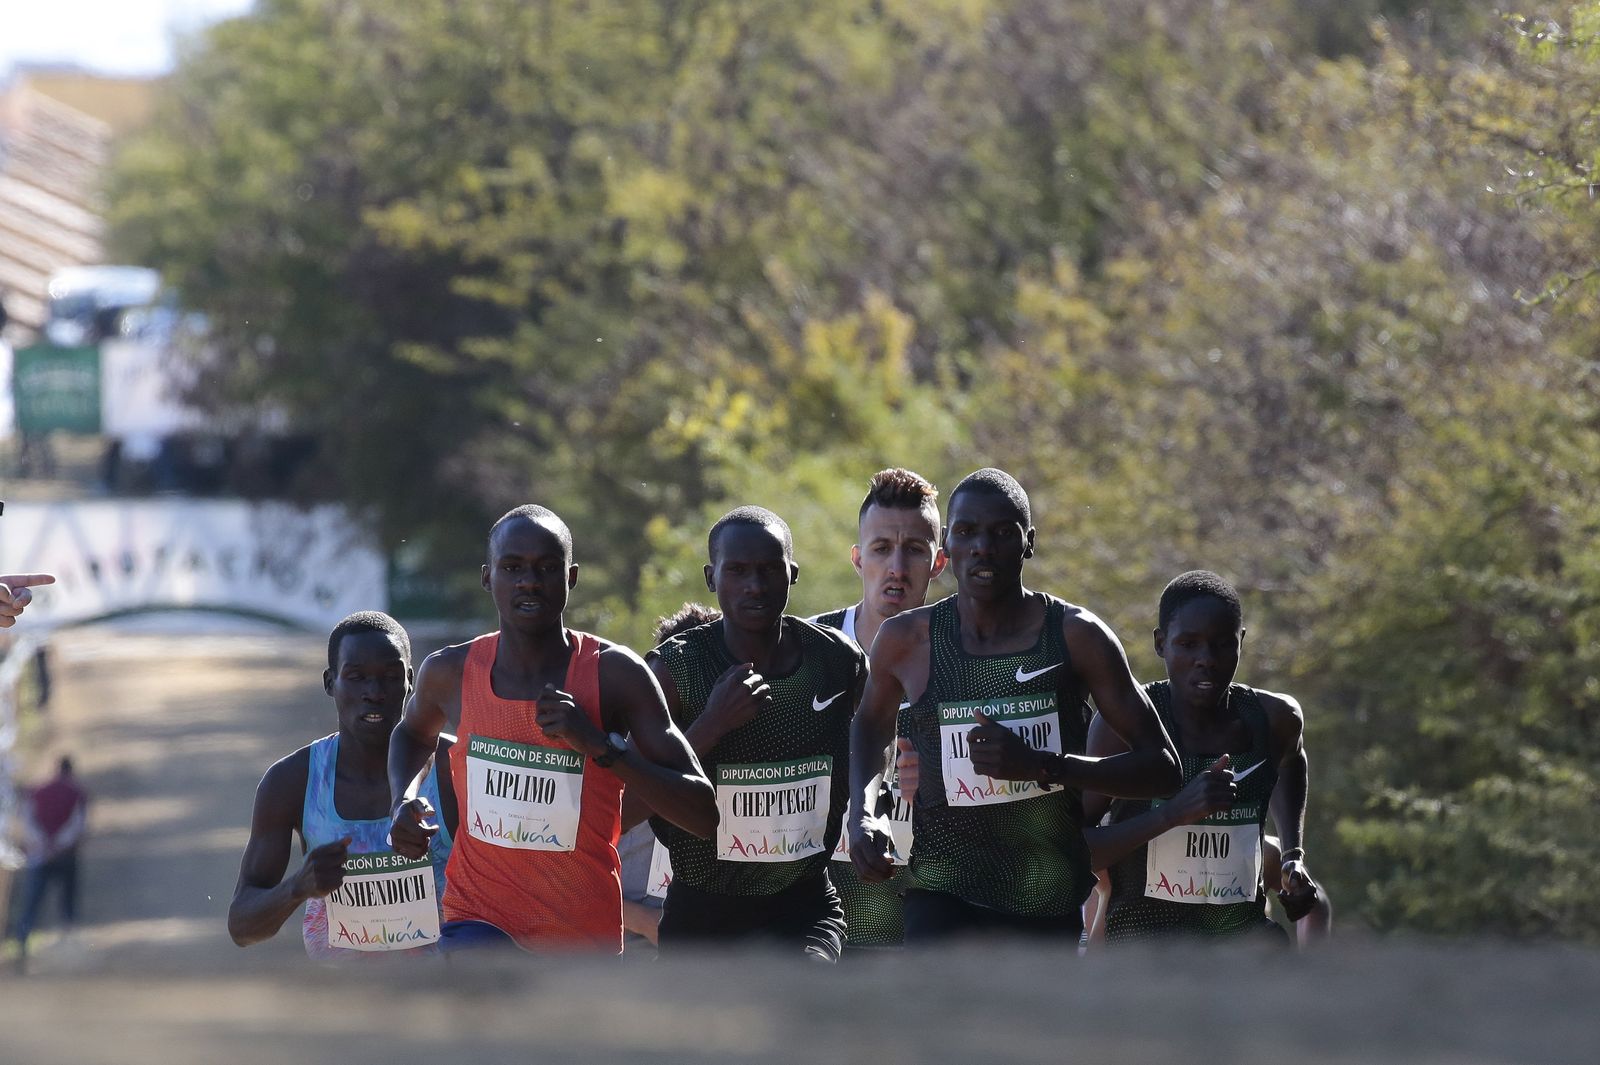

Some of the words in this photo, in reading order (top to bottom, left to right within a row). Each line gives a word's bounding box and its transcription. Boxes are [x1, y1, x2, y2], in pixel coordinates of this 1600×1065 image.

[1003, 702, 1016, 714] DE
[1018, 698, 1055, 712] SEVILLA
[471, 740, 525, 762] DIPUTACION
[529, 750, 542, 763] DE
[544, 753, 581, 768] SEVILLA
[722, 767, 782, 780] DIPUTACION
[784, 765, 796, 777] DE
[797, 760, 828, 775] SEVILLA
[484, 768, 556, 805] KIPLIMO
[732, 784, 818, 817] CHEPTEGEI
[1230, 807, 1257, 820] SEVILLA
[473, 811, 565, 848] Andalucía
[728, 830, 817, 857] Andalucía
[1185, 831, 1230, 859] RONO
[376, 856, 389, 868] DE
[1155, 871, 1247, 897] Andalucía
[337, 920, 430, 945] Andalucía
